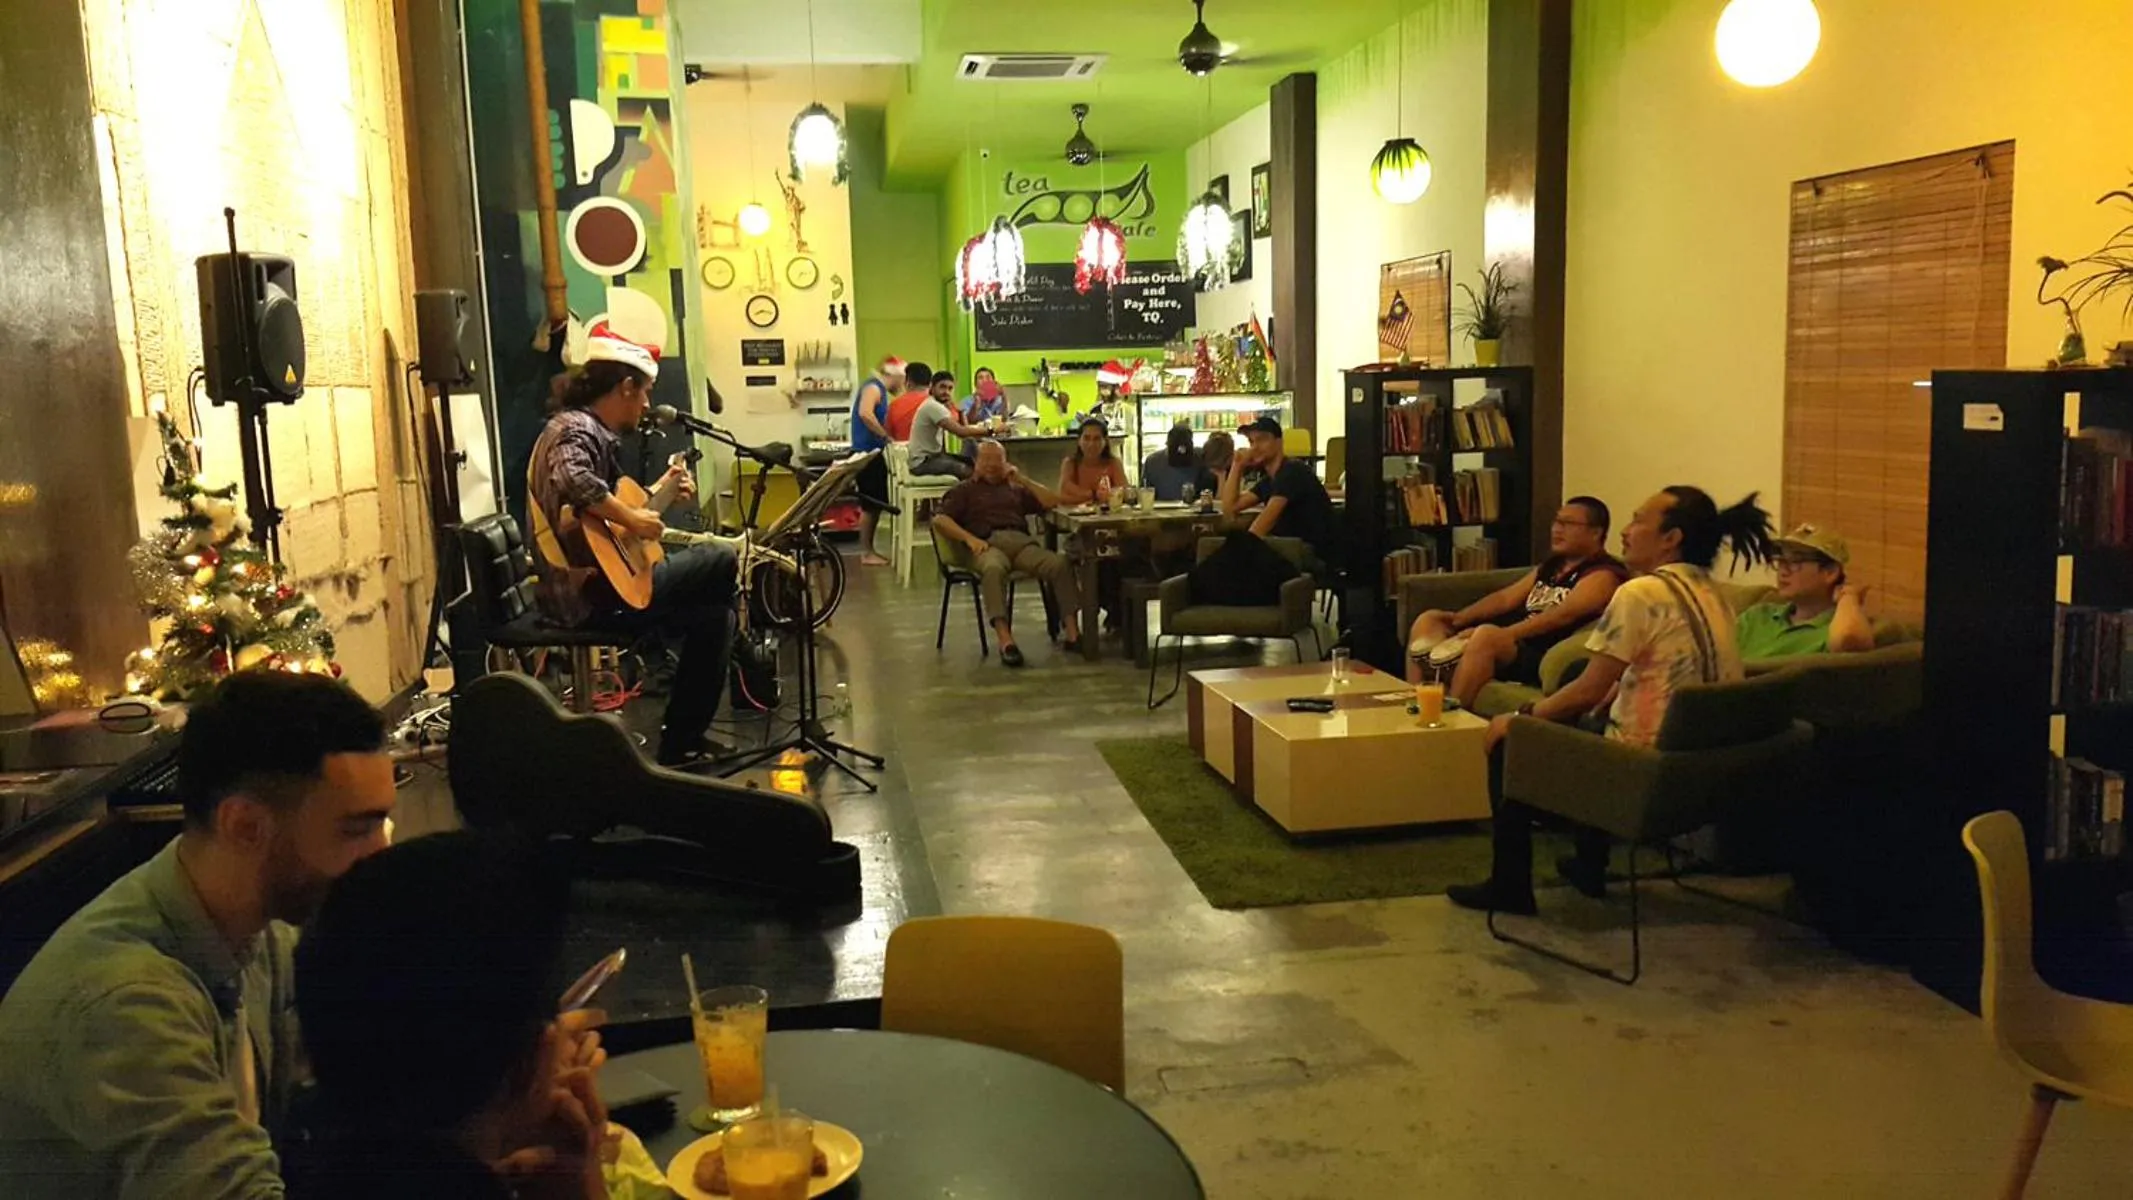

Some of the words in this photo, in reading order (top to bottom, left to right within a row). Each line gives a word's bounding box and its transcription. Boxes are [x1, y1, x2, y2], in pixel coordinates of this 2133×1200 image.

[1004, 171, 1048, 194] tea
[1120, 220, 1156, 237] afe
[1113, 273, 1150, 285] lease
[1142, 285, 1166, 296] and
[1123, 299, 1146, 312] Pay
[1148, 298, 1182, 310] Here,
[1141, 311, 1164, 324] TQ.
